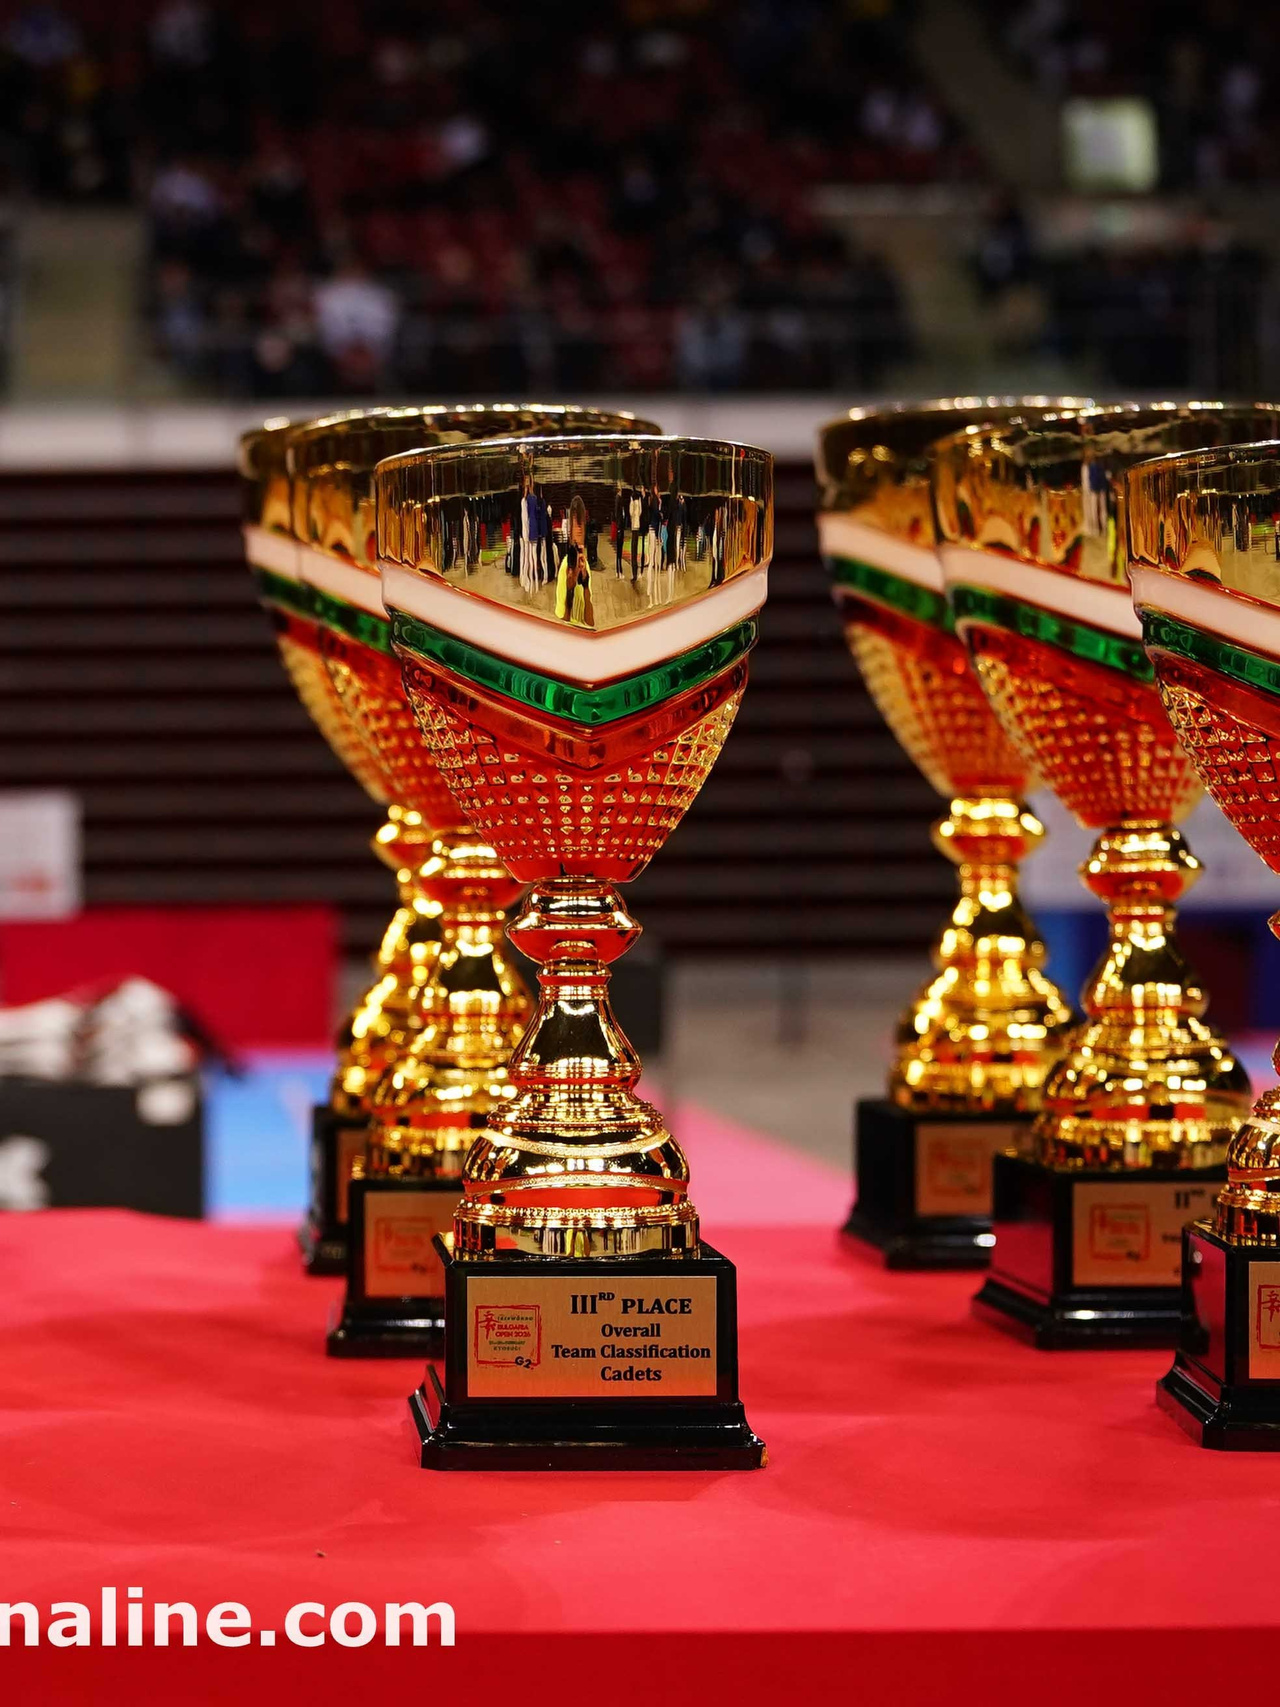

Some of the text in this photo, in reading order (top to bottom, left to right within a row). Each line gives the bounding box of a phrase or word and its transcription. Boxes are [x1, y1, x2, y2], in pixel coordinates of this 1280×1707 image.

[621, 1298, 692, 1315] PLACE
[601, 1323, 661, 1338] Overall
[551, 1344, 711, 1359] Team Classification
[514, 1356, 532, 1369] G2
[600, 1366, 662, 1381] Cadets
